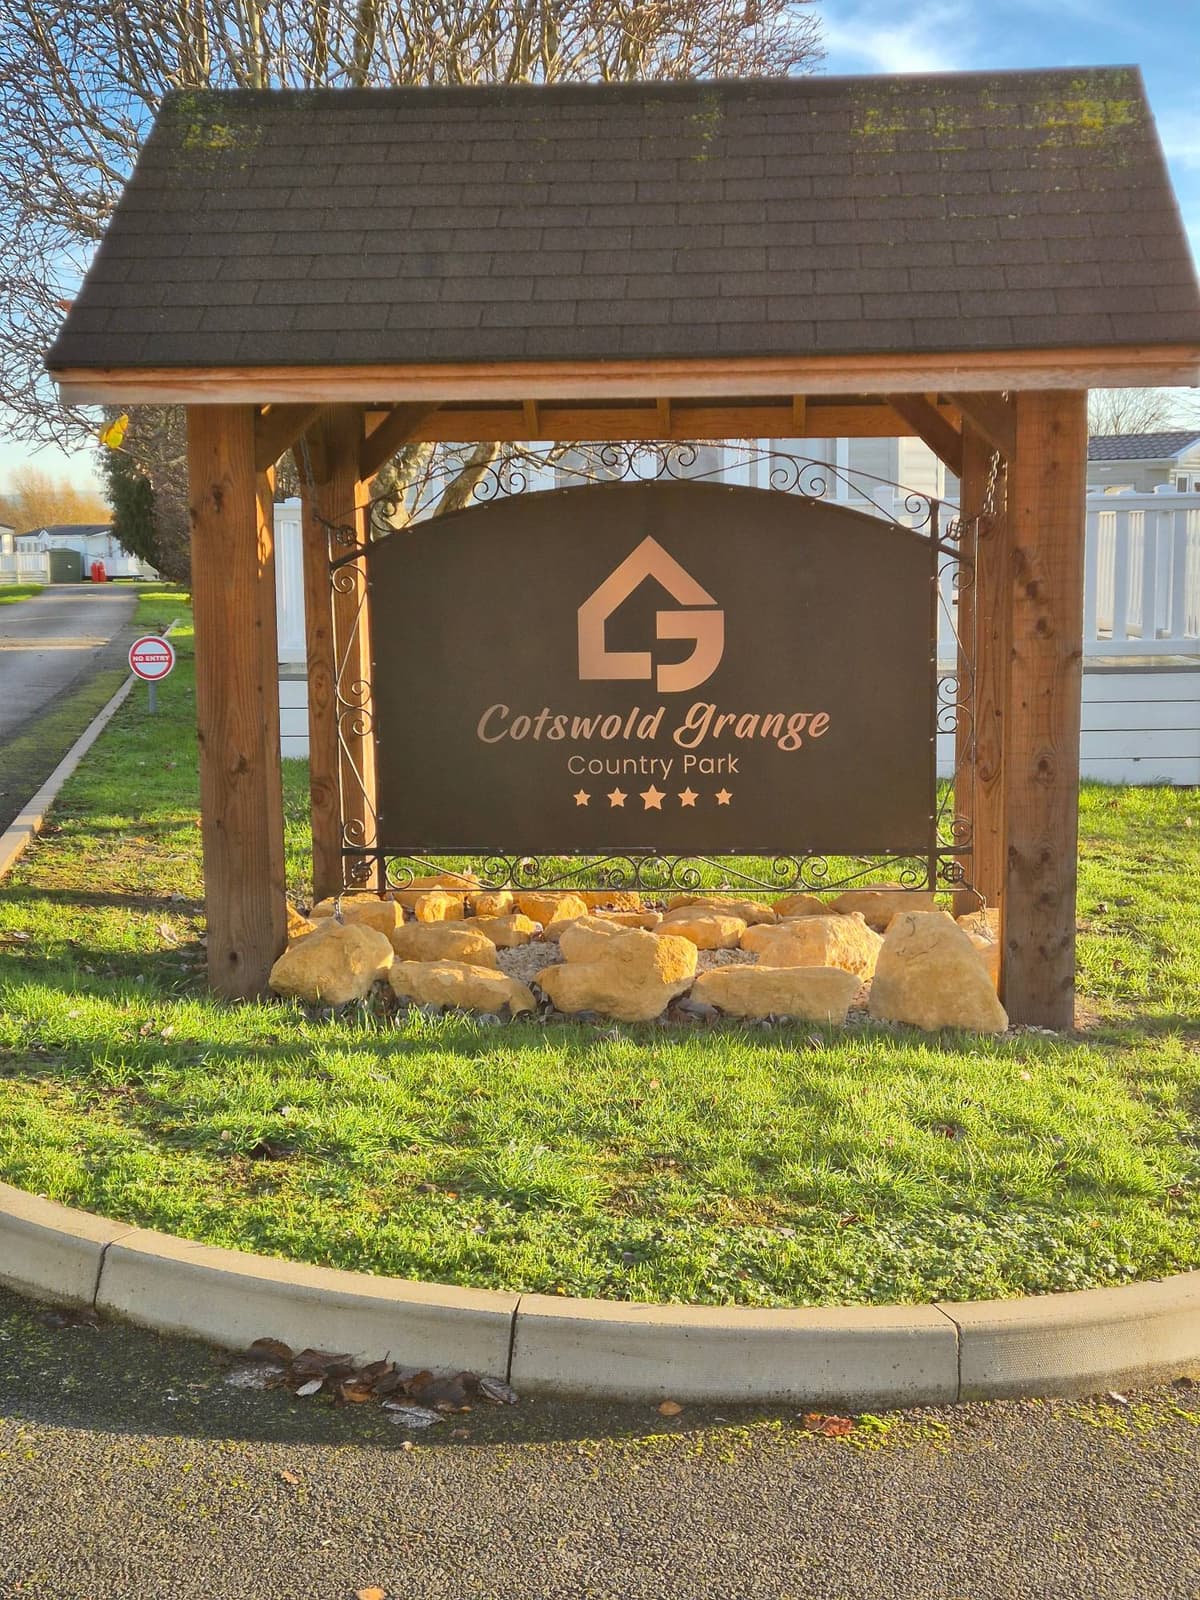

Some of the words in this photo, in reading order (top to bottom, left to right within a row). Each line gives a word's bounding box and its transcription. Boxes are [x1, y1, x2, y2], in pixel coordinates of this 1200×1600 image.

[476, 703, 666, 743] Cotswold
[673, 702, 831, 751] Grange
[567, 754, 673, 780] Country
[683, 753, 740, 774] Park
